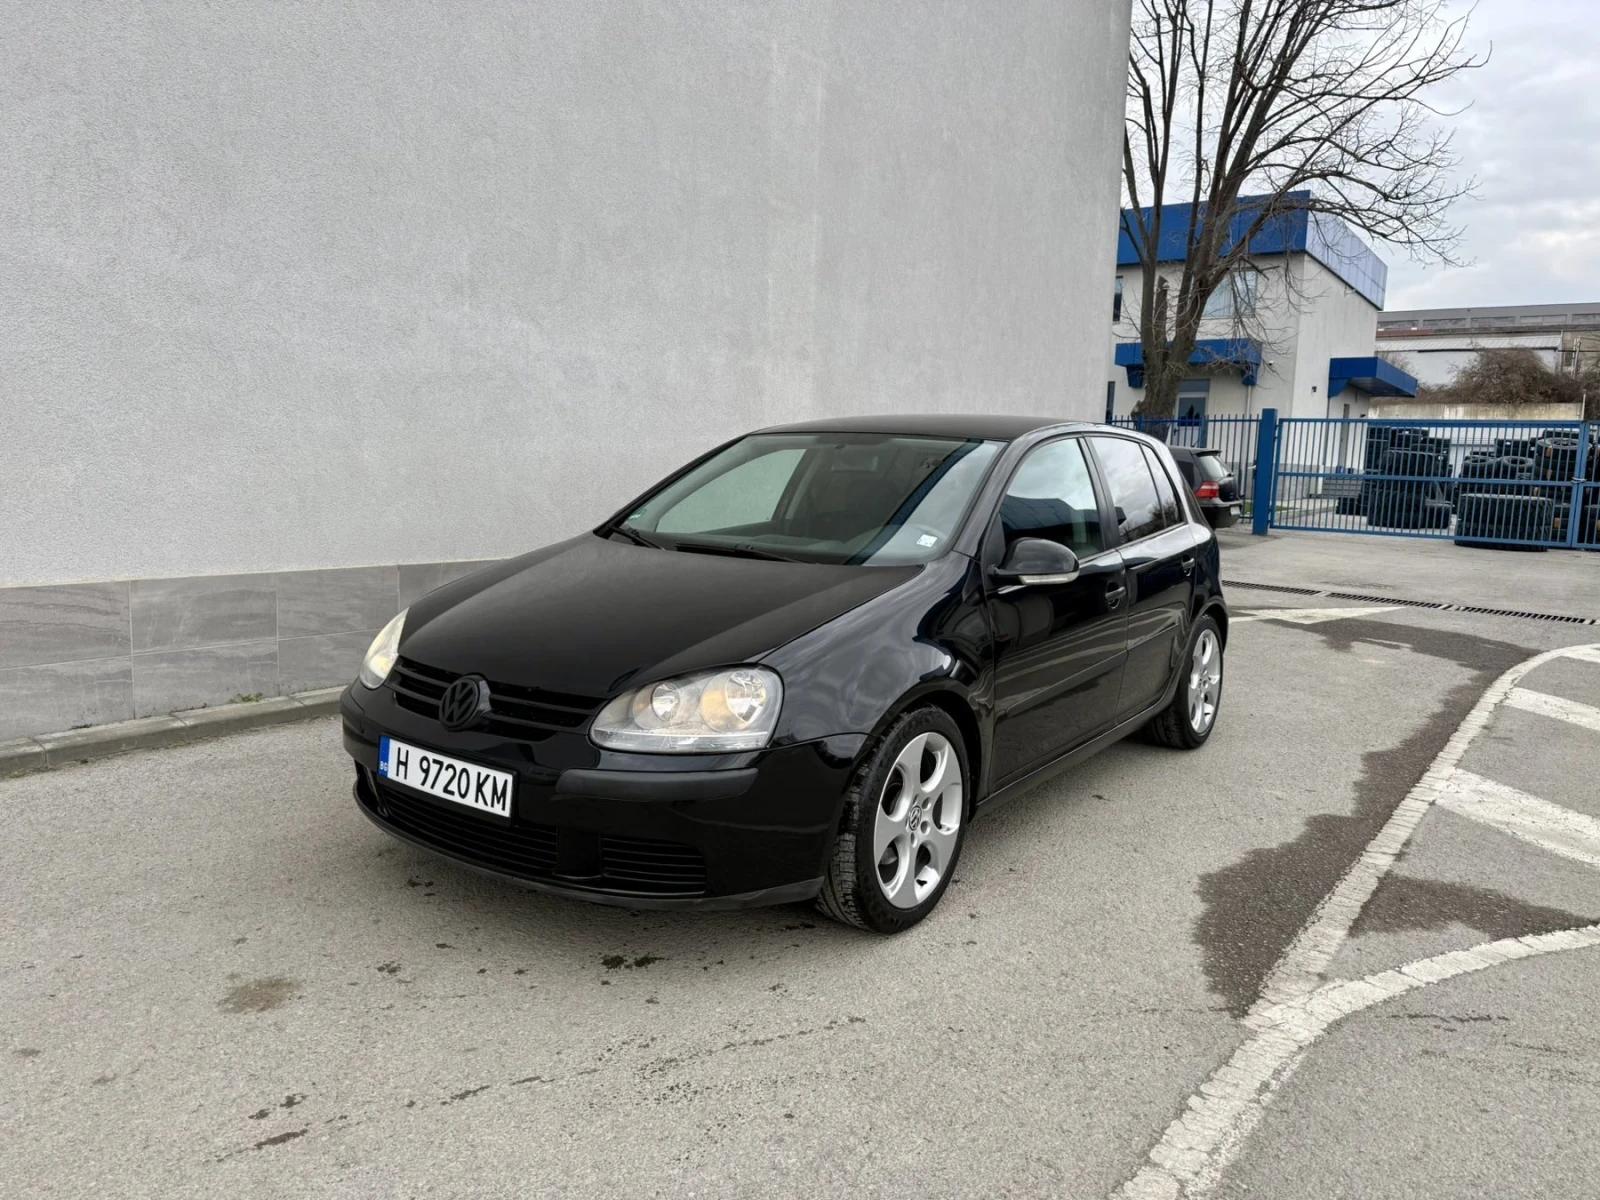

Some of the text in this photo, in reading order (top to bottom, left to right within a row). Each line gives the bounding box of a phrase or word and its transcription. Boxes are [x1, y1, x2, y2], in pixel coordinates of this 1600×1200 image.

[380, 761, 388, 772] BG
[396, 747, 508, 811] H 9720 KM
